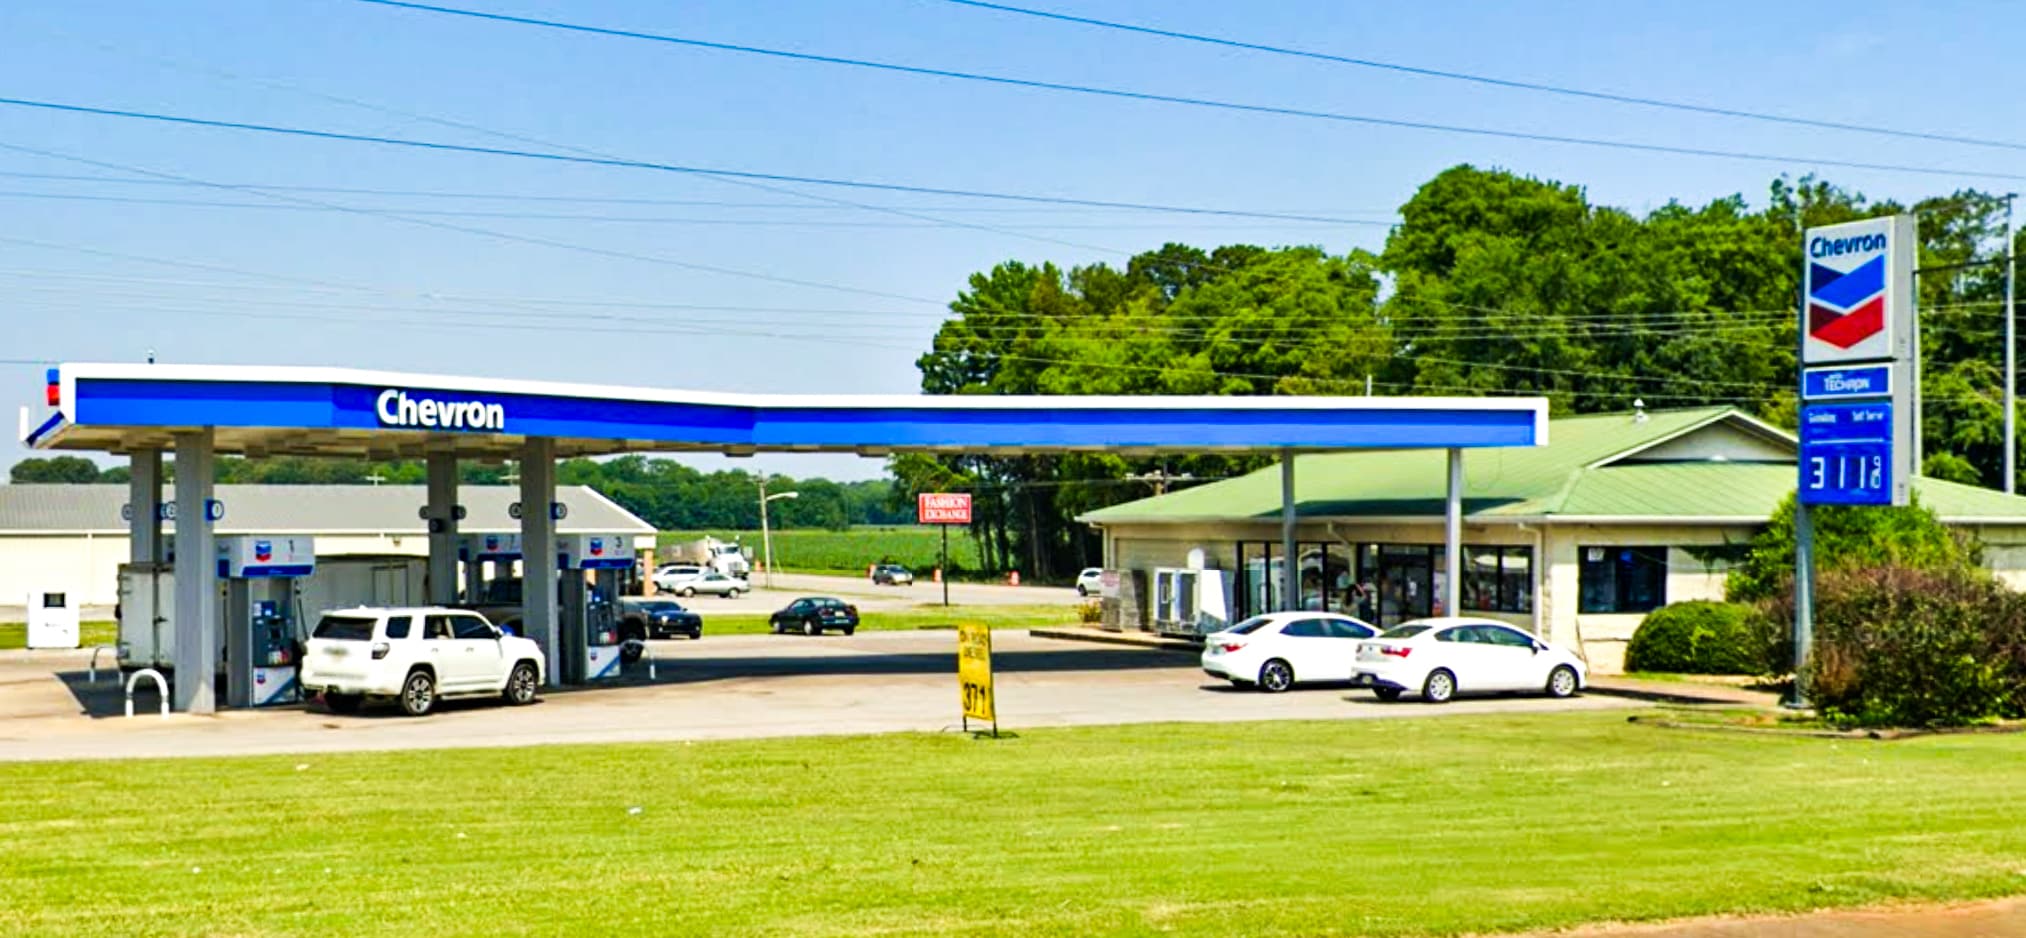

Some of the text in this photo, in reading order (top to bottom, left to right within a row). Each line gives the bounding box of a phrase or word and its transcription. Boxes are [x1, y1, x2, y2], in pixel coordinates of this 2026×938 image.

[1810, 233, 1886, 258] Chevron
[377, 388, 504, 429] Chevron
[925, 497, 967, 508] FASHION
[963, 681, 986, 714] 371
